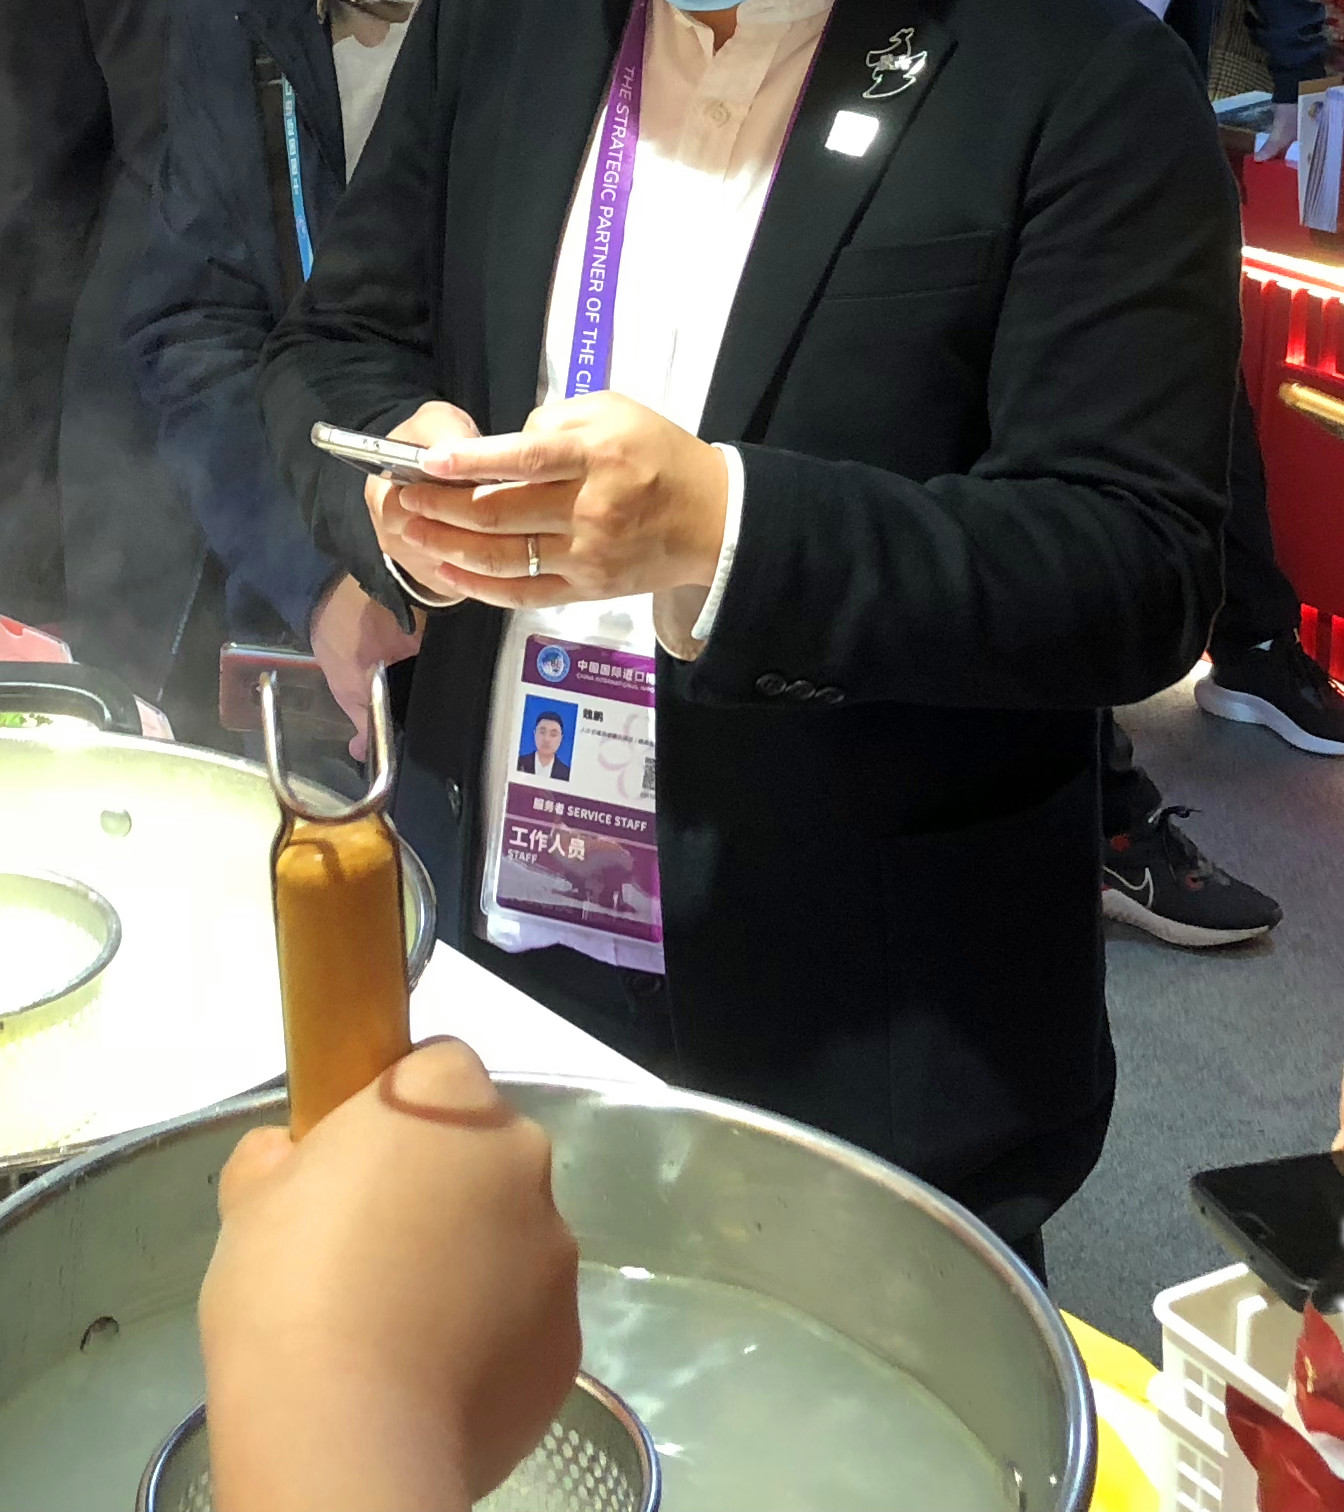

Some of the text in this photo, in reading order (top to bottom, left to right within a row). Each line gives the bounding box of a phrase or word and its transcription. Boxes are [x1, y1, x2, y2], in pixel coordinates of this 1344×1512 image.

[574, 65, 635, 396] THE STRATEGIC PARTNER OF THE CII
[567, 805, 612, 826] SERVICE
[614, 815, 648, 833] STAFF
[507, 848, 538, 865] STAFF
[508, 826, 586, 861] 工作人员
